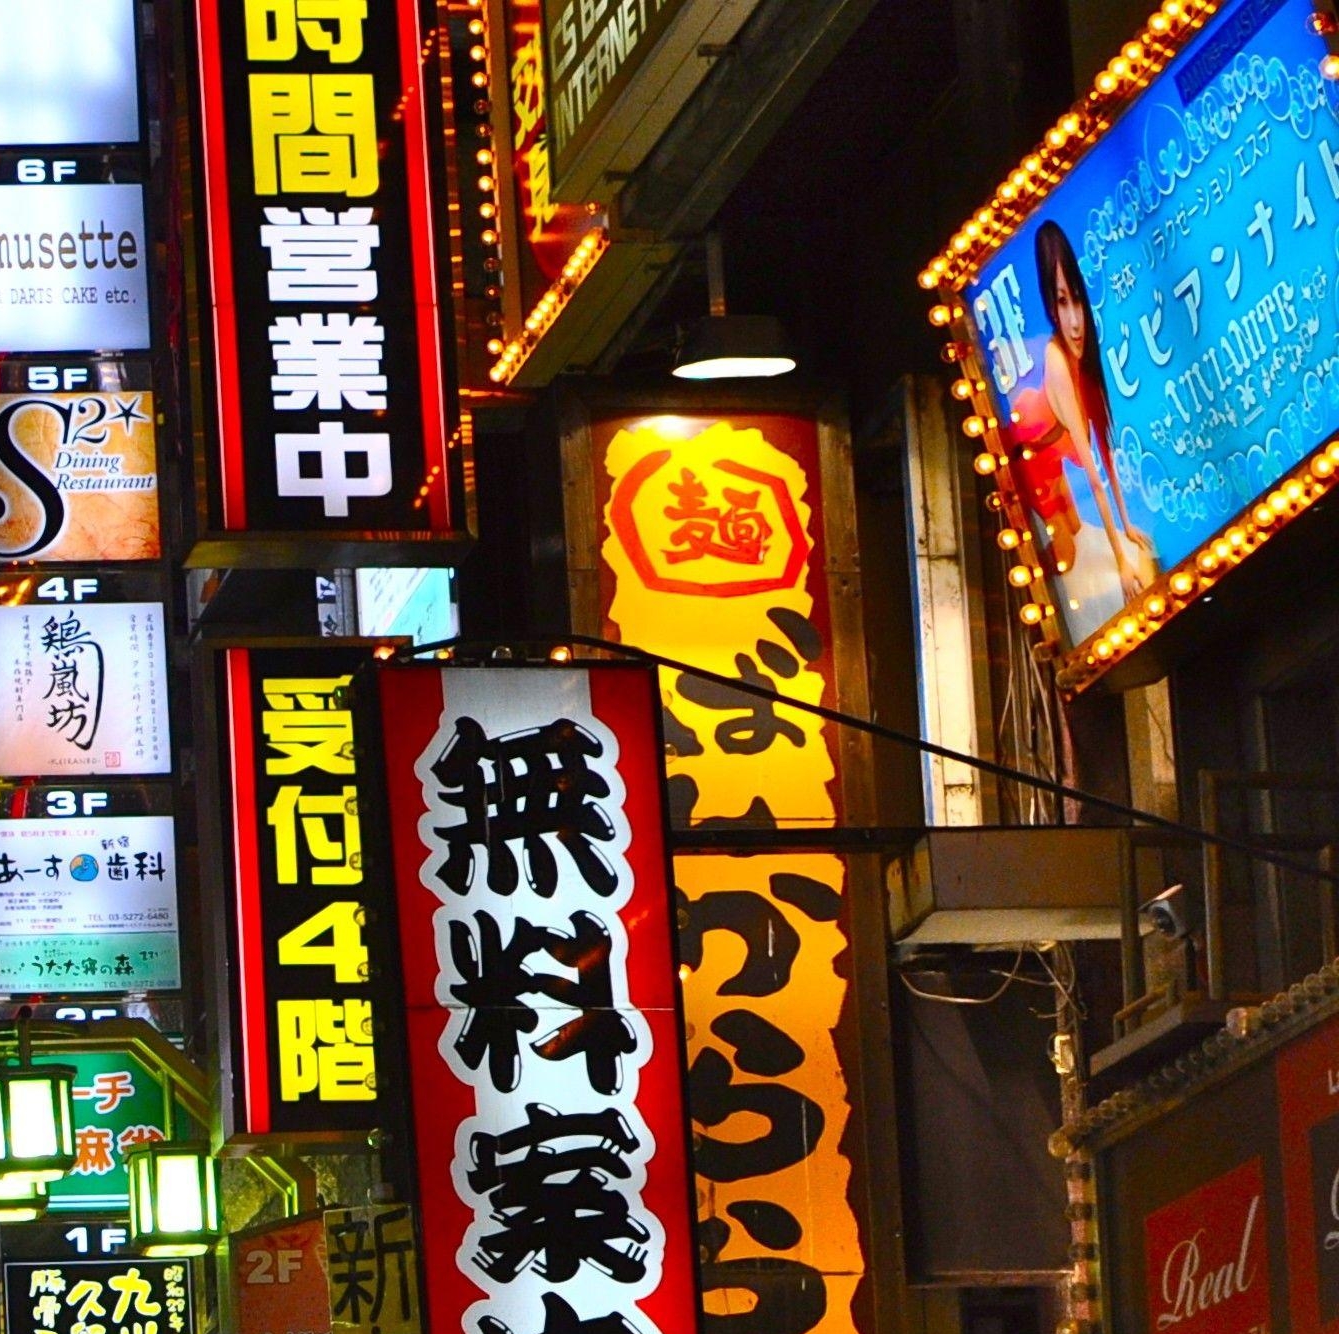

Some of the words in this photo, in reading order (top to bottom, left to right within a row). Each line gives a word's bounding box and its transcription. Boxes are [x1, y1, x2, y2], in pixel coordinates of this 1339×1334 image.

[17, 159, 77, 183] 6F
[10, 287, 54, 304] DARTS
[61, 286, 98, 304] CAKE
[105, 287, 137, 304] etc.
[973, 264, 1034, 396] 3F
[28, 366, 88, 391] 5F
[54, 450, 121, 473] Dining
[56, 472, 155, 492] Restaurant
[37, 578, 98, 601] 4F
[46, 791, 107, 816] 3F
[107, 852, 165, 881] 歯科
[262, 675, 377, 1102] 受付4階
[32, 955, 135, 976] うたた寝の森
[66, 1227, 127, 1252] 1F
[246, 1251, 304, 1284] 2F
[1156, 1196, 1259, 1330] Real
